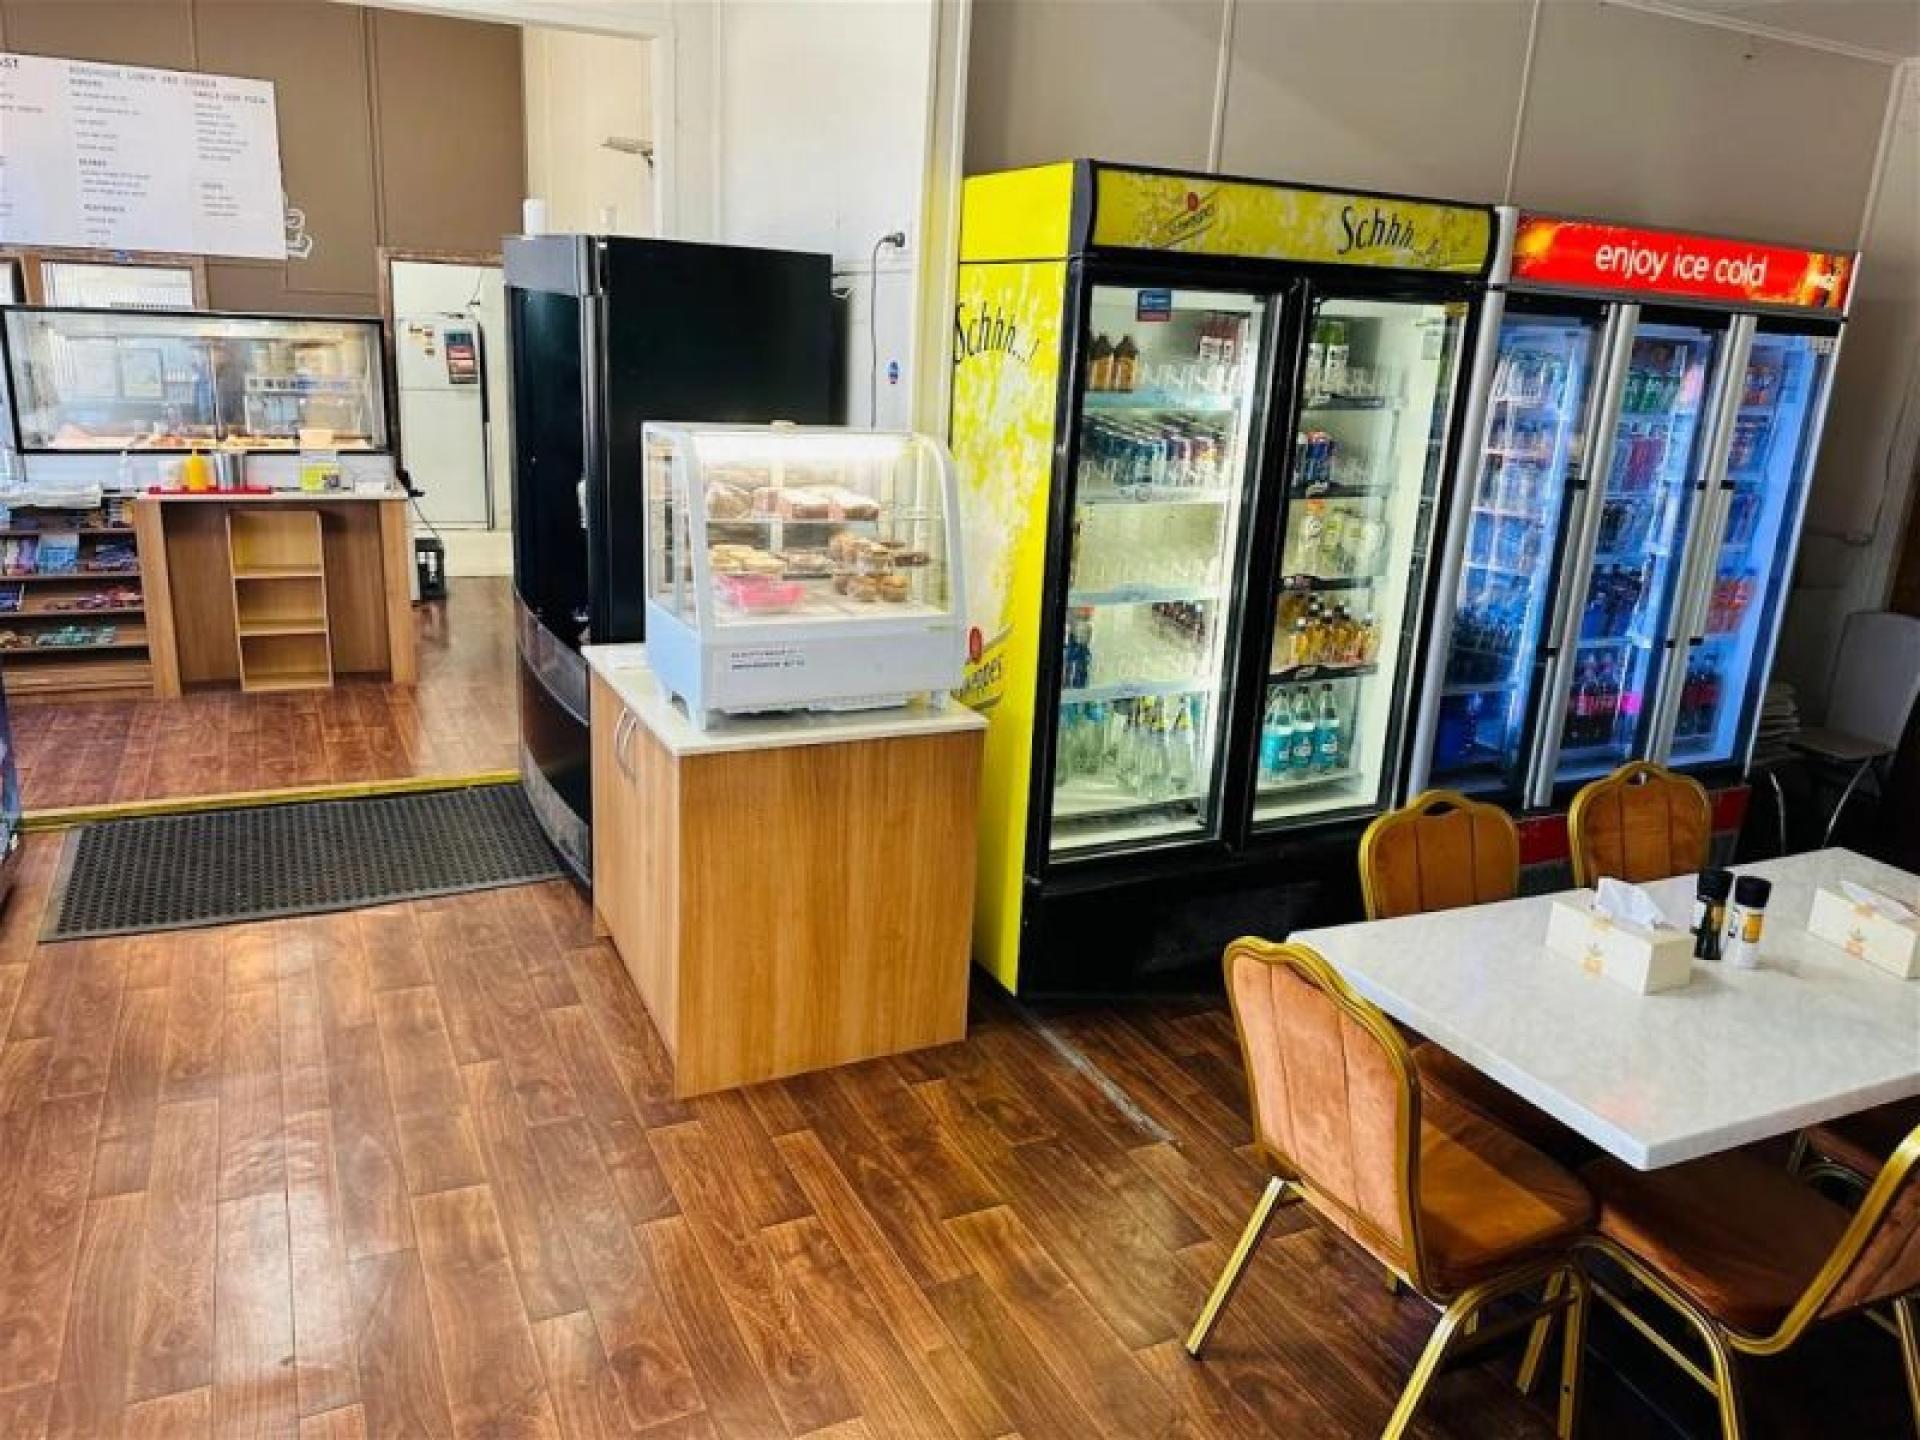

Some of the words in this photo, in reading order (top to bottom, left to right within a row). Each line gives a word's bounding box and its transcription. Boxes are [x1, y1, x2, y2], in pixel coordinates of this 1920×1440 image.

[1595, 240, 1669, 282] enjoy
[1673, 245, 1710, 281] ice
[1714, 252, 1768, 287] cold
